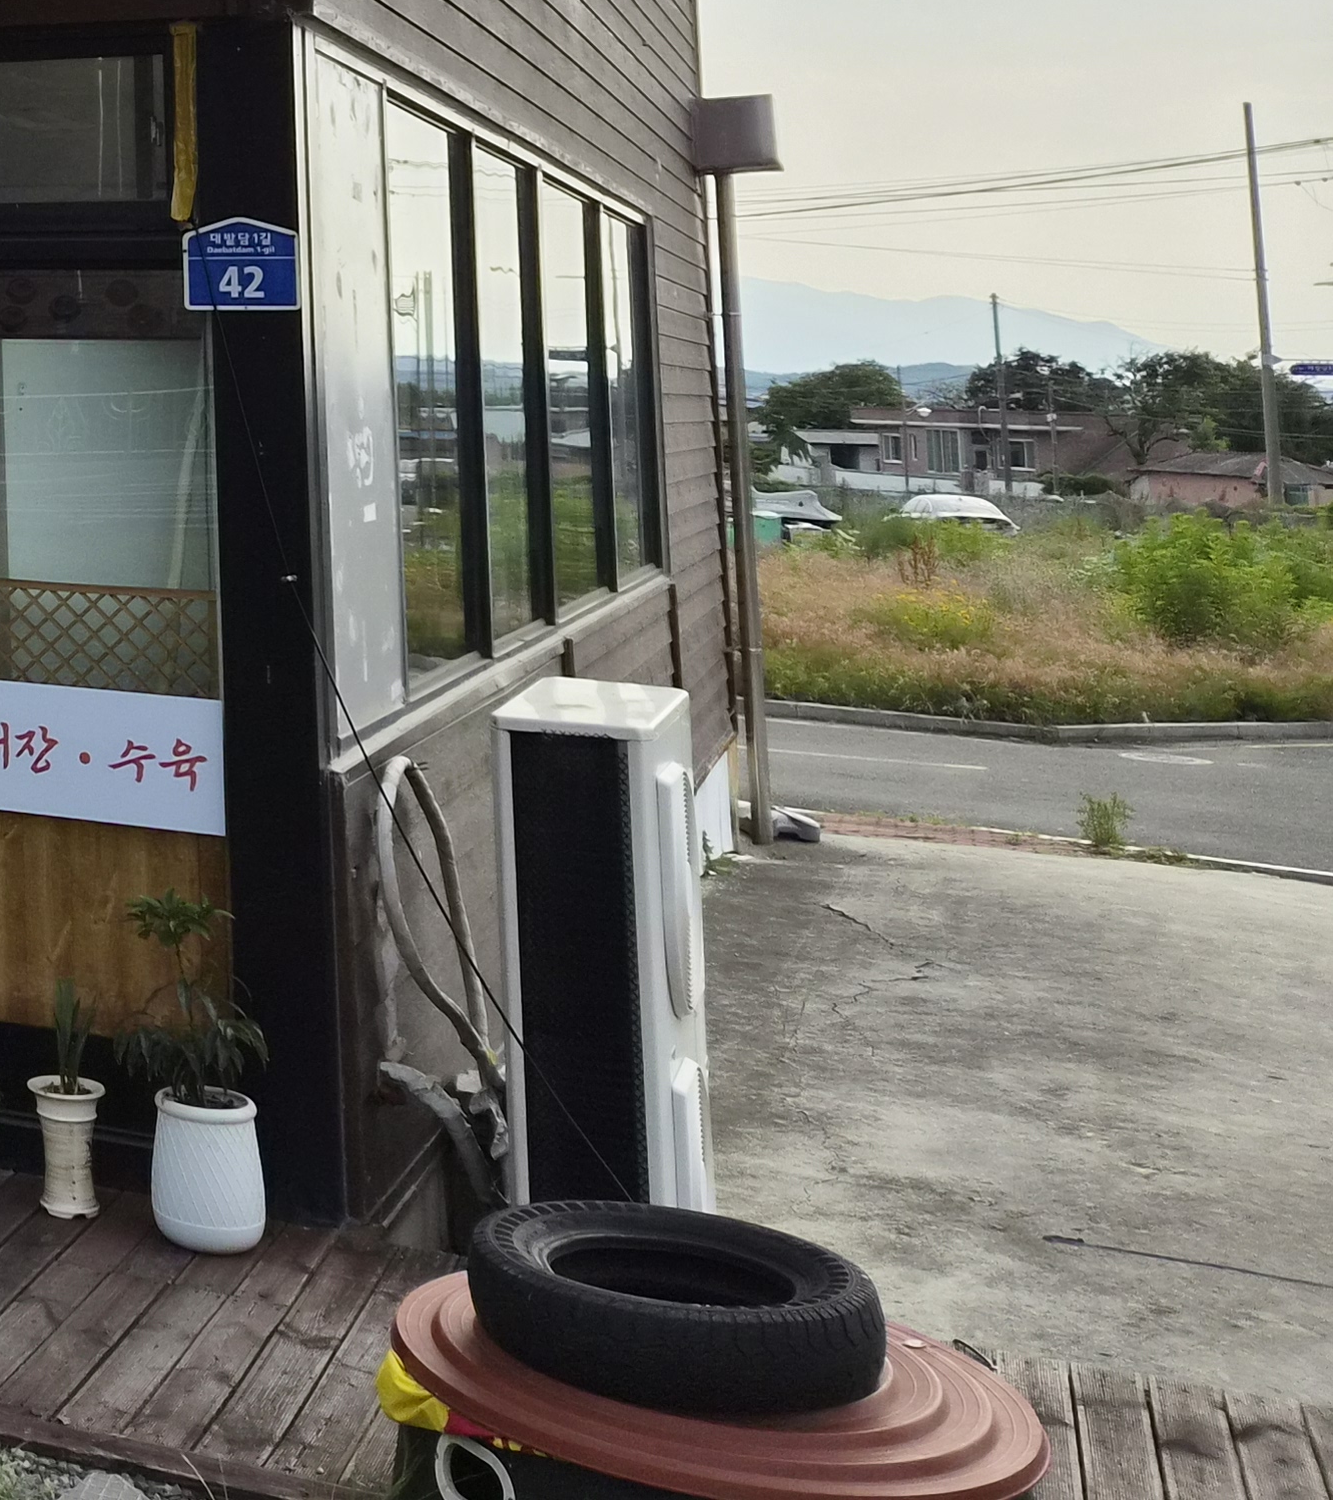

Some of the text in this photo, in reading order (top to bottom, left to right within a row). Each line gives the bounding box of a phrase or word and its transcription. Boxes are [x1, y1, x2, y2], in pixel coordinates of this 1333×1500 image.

[256, 246, 275, 255] 1-gil
[218, 265, 265, 299] 42
[107, 738, 208, 792] 수육
